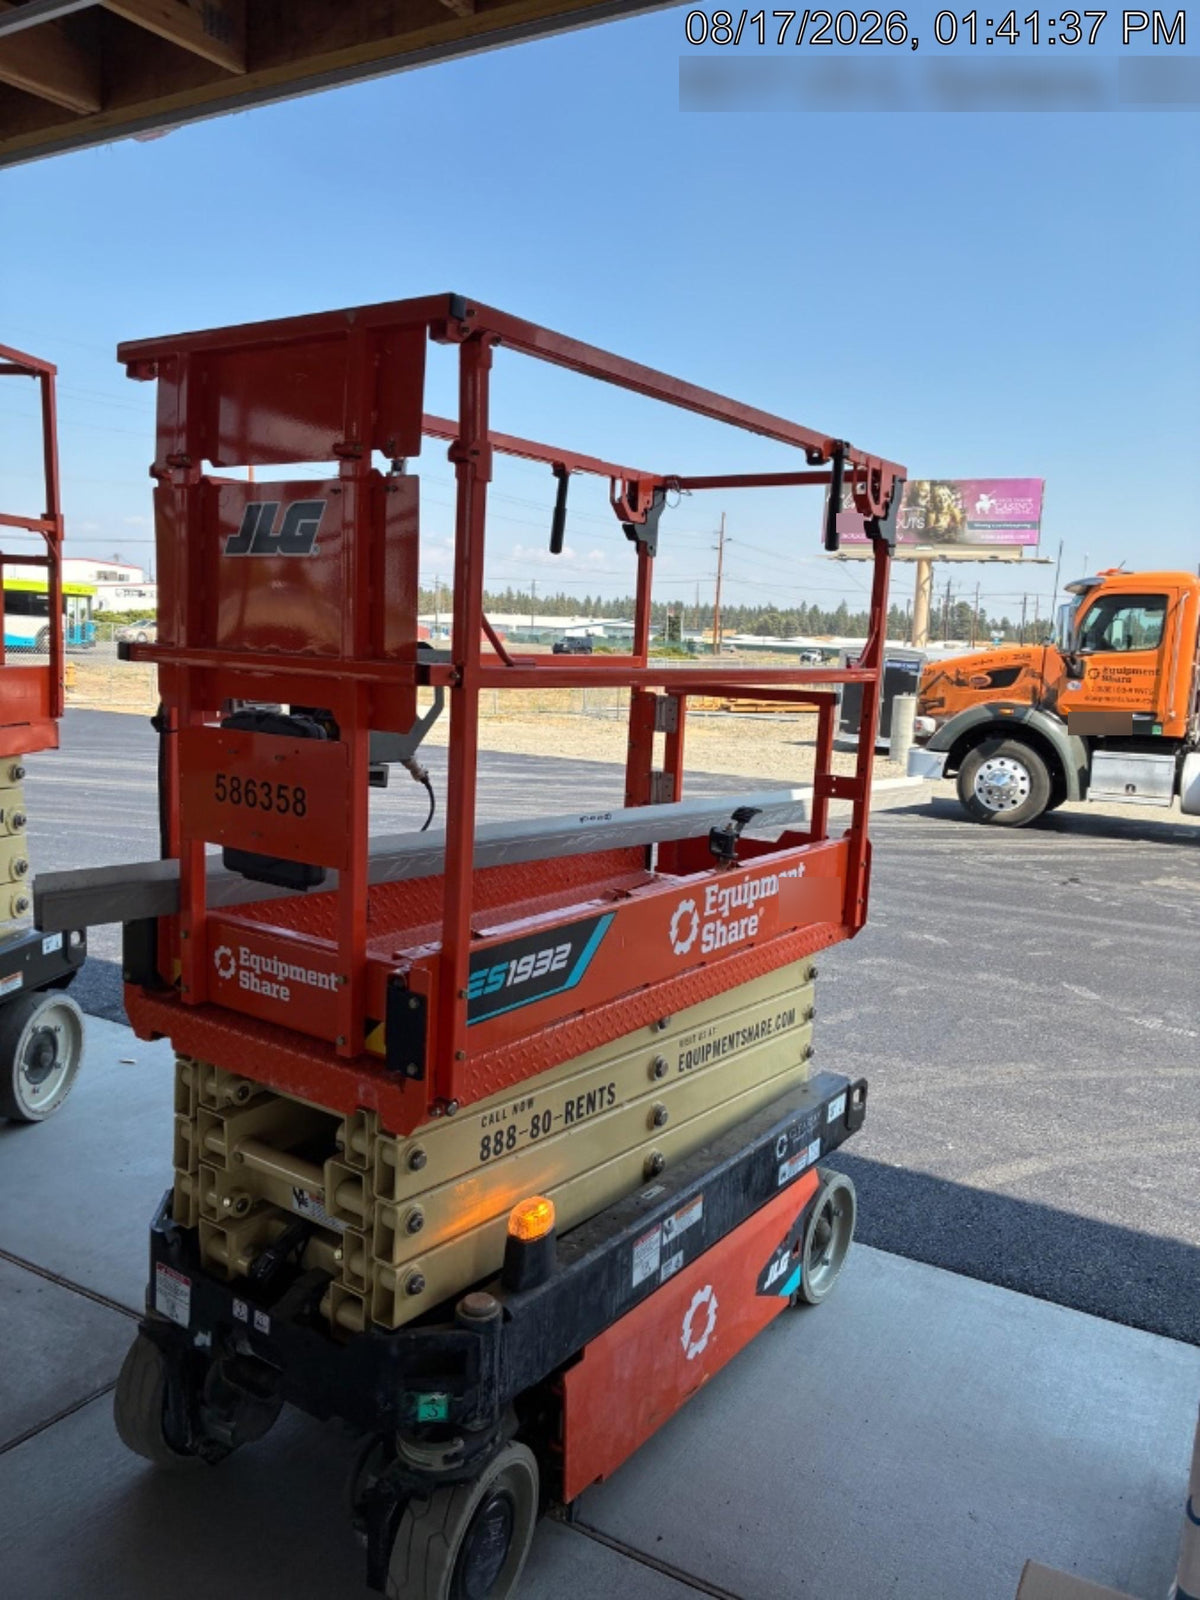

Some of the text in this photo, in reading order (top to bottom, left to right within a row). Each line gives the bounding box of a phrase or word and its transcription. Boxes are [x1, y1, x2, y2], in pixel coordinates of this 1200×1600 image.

[223, 499, 328, 558] JLG
[214, 773, 307, 818] 586358
[701, 913, 760, 955] Share
[239, 946, 339, 992] Equipment
[239, 969, 290, 1001] Share
[467, 942, 573, 999] ES1932
[678, 1008, 796, 1073] EQUIPMENTSHARE.COM
[480, 1082, 616, 1161] 888-80-RENTS
[481, 1097, 535, 1128] CALL NOW
[763, 1249, 791, 1291] JLG
